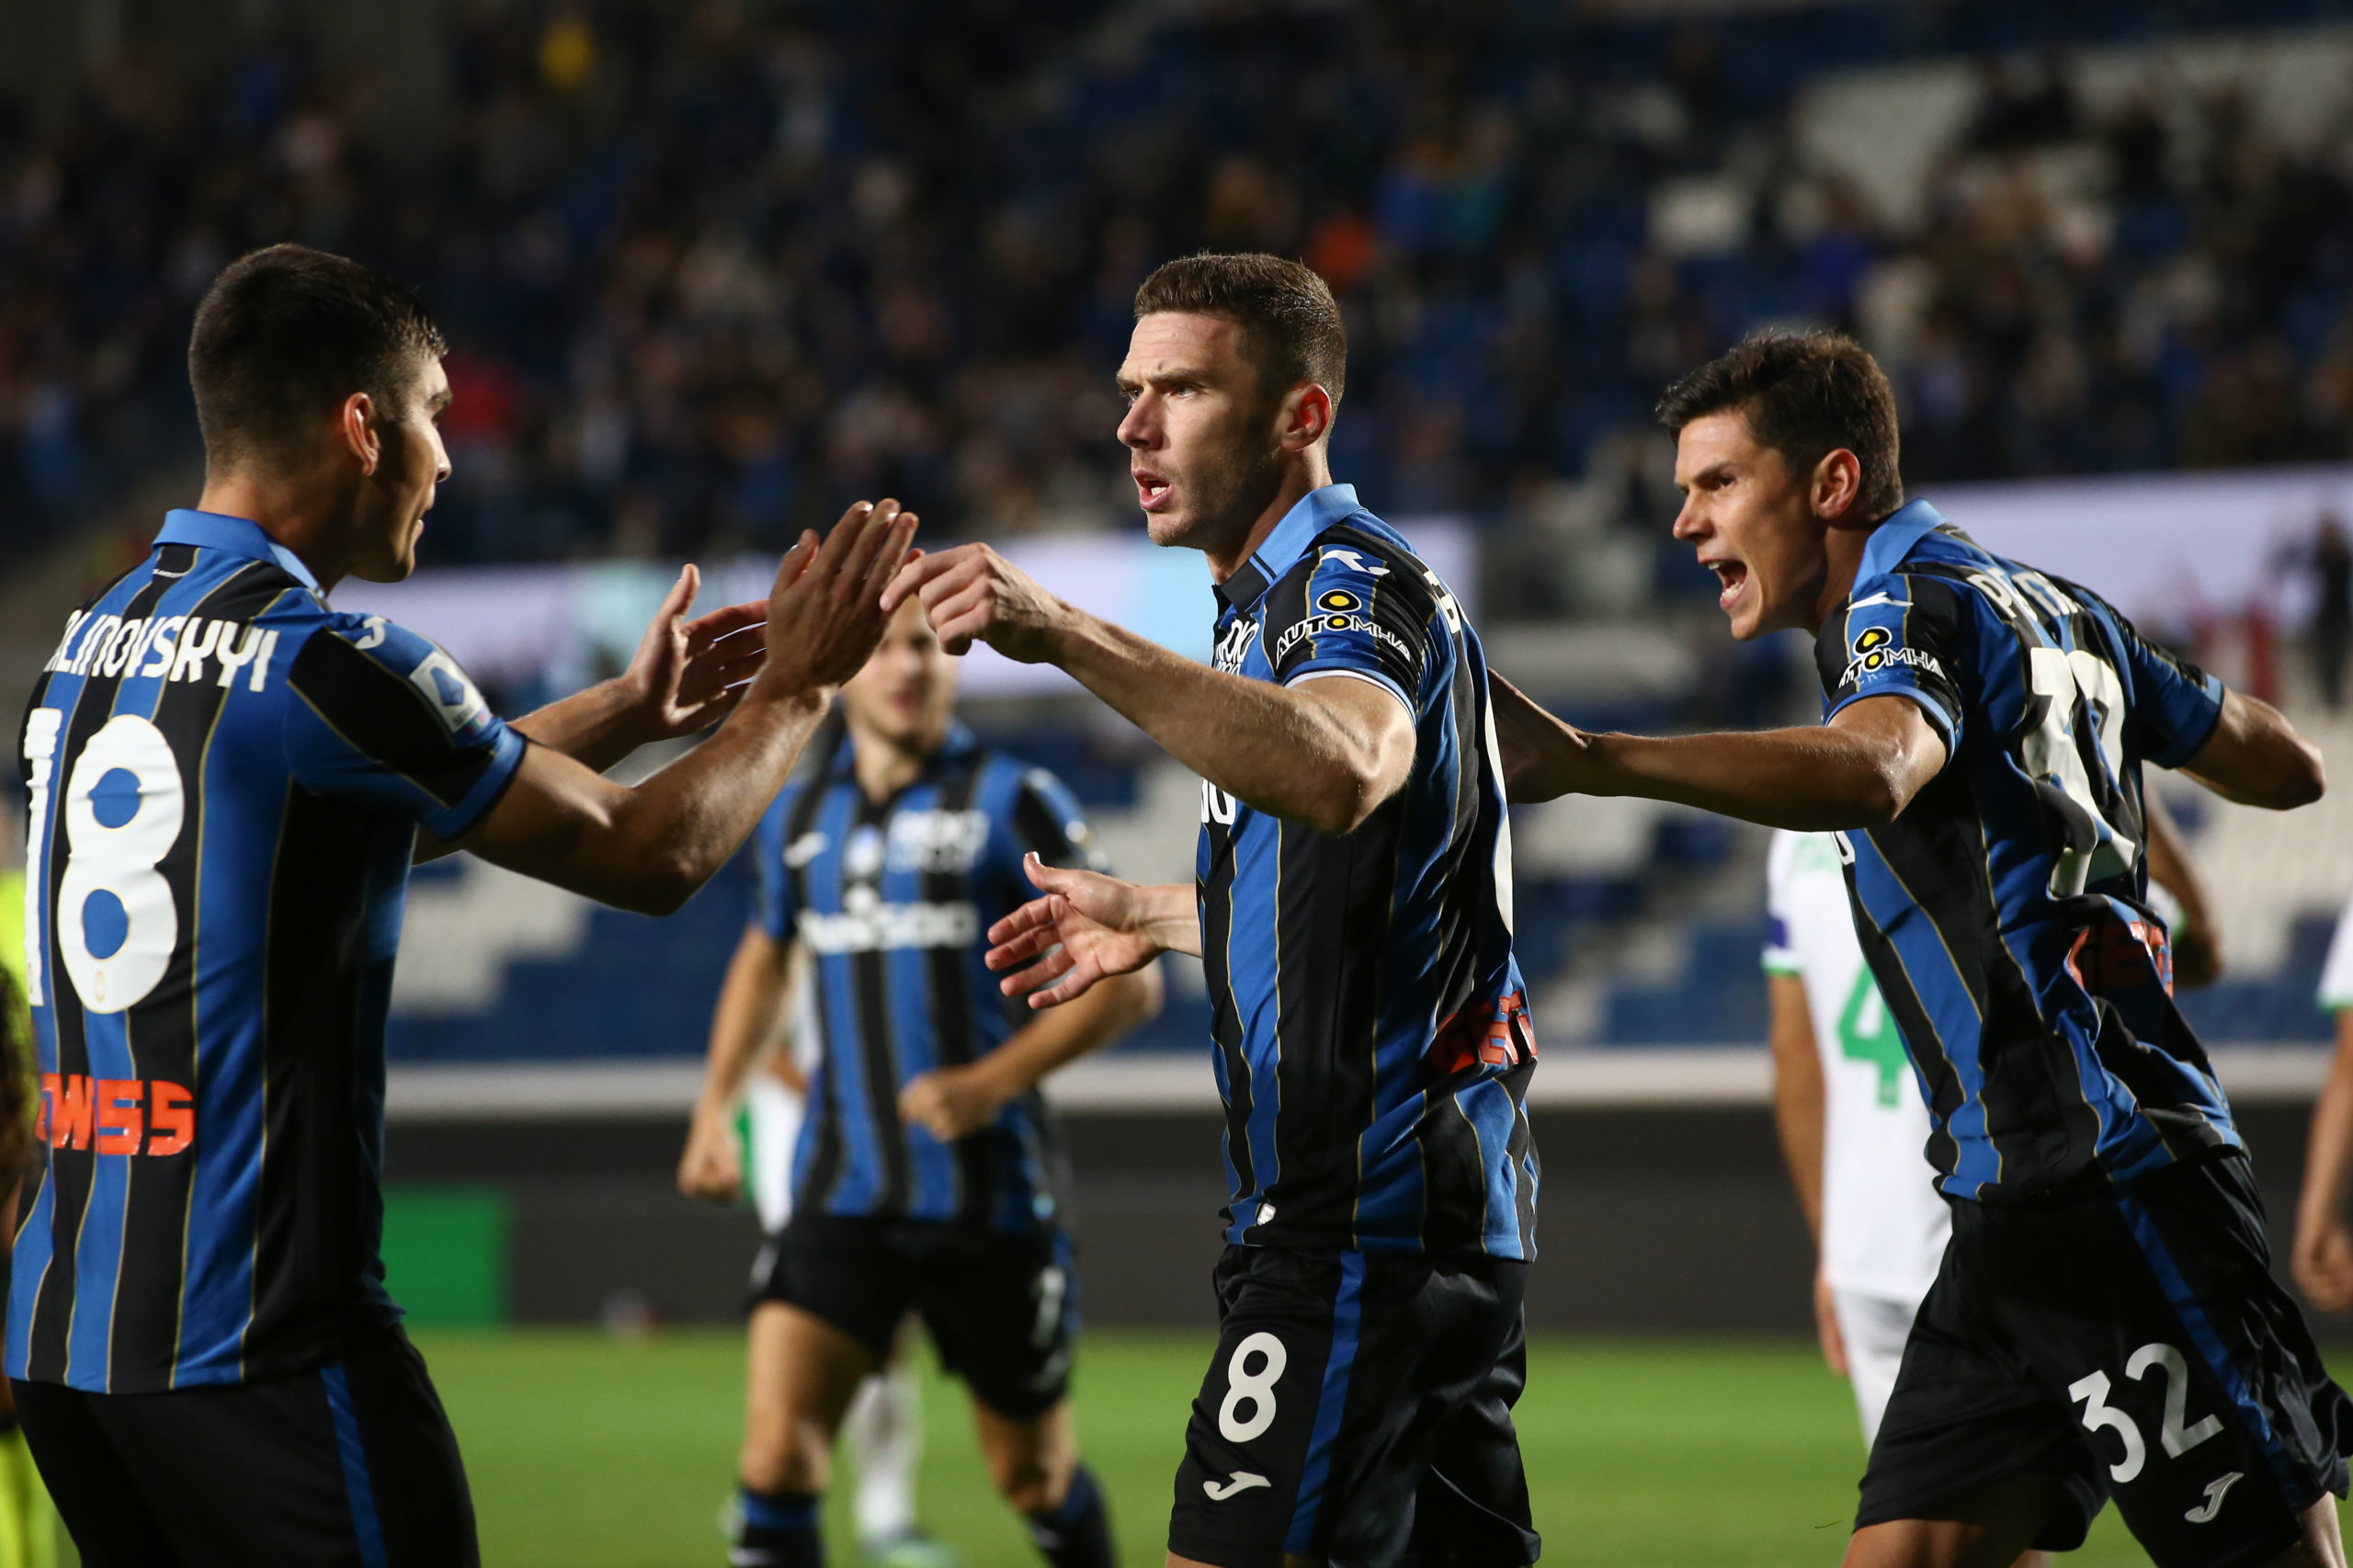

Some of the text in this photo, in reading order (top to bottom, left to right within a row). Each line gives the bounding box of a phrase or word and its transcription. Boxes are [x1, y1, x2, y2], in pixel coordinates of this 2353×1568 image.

[24, 707, 184, 1015] 18
[1219, 1332, 1287, 1443] 8
[2068, 1343, 2224, 1483] 32
